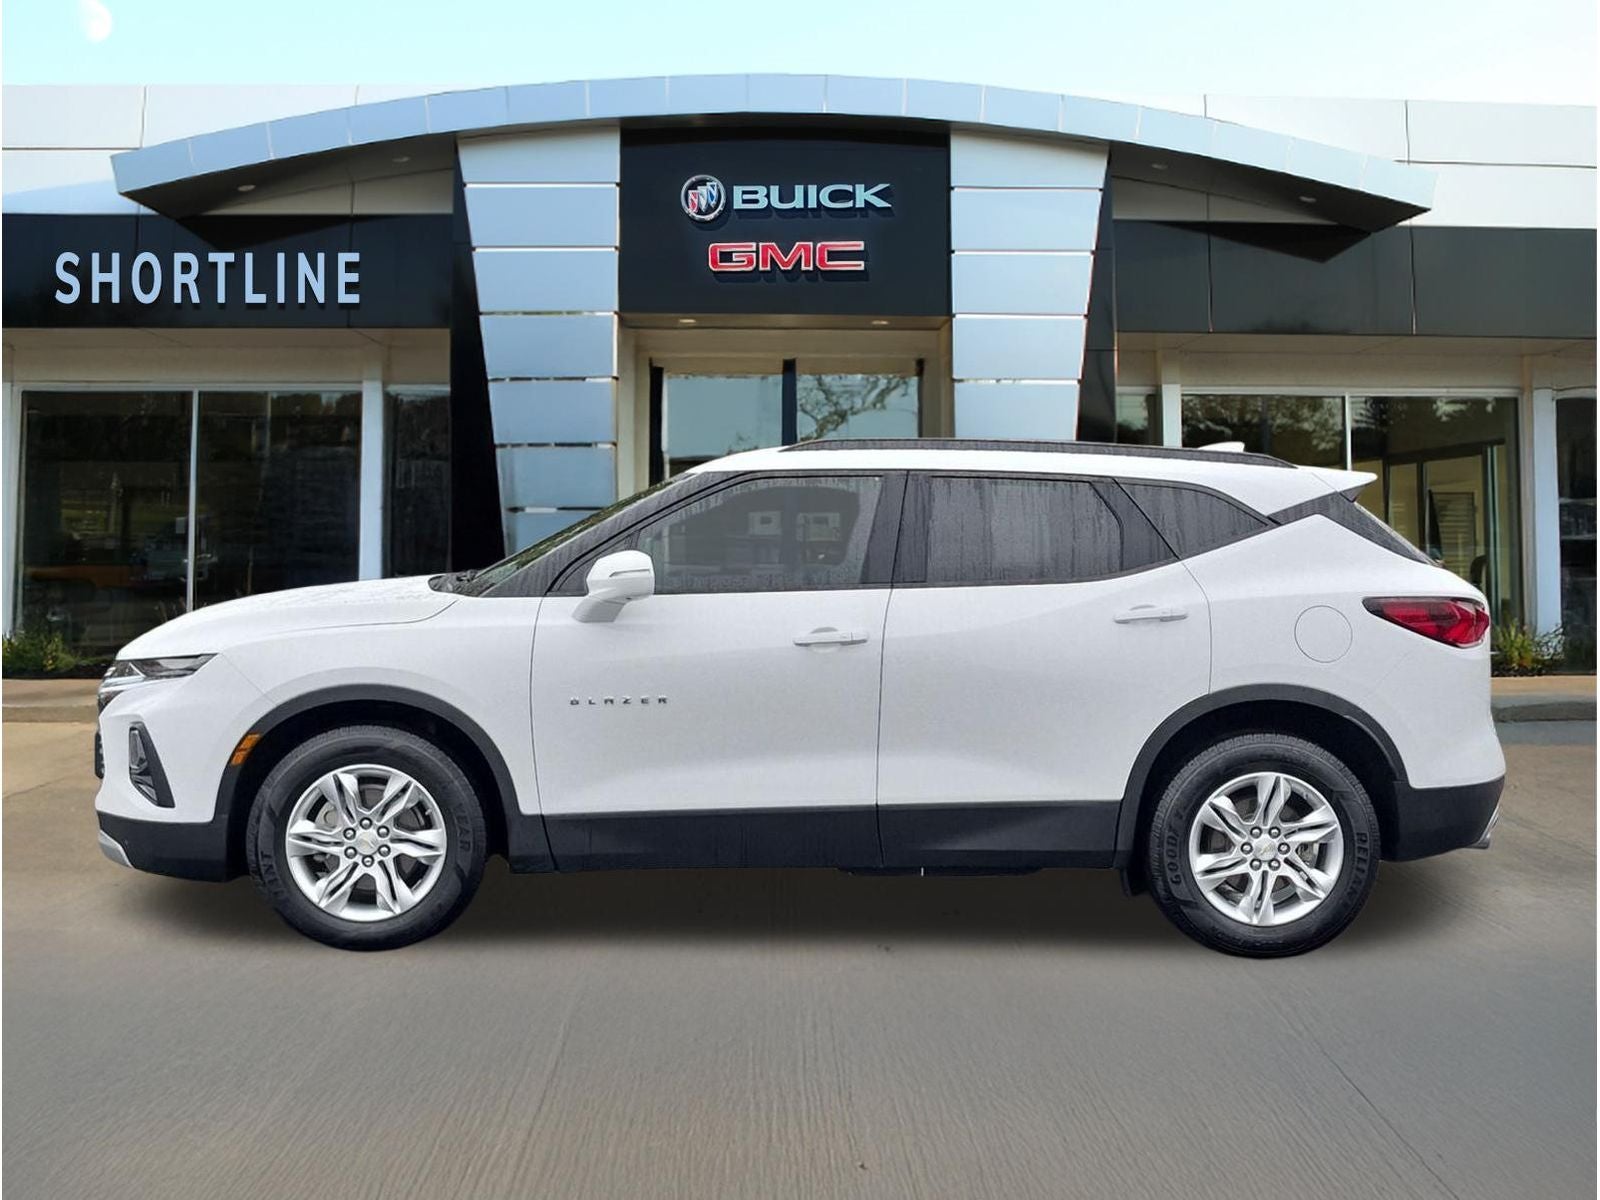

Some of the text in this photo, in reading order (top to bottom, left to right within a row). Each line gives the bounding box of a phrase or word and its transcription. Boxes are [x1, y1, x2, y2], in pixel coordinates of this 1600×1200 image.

[733, 183, 892, 210] BUICK
[708, 241, 865, 271] GMC
[54, 251, 360, 304] SHORTLINE
[569, 696, 668, 706] BLAZER
